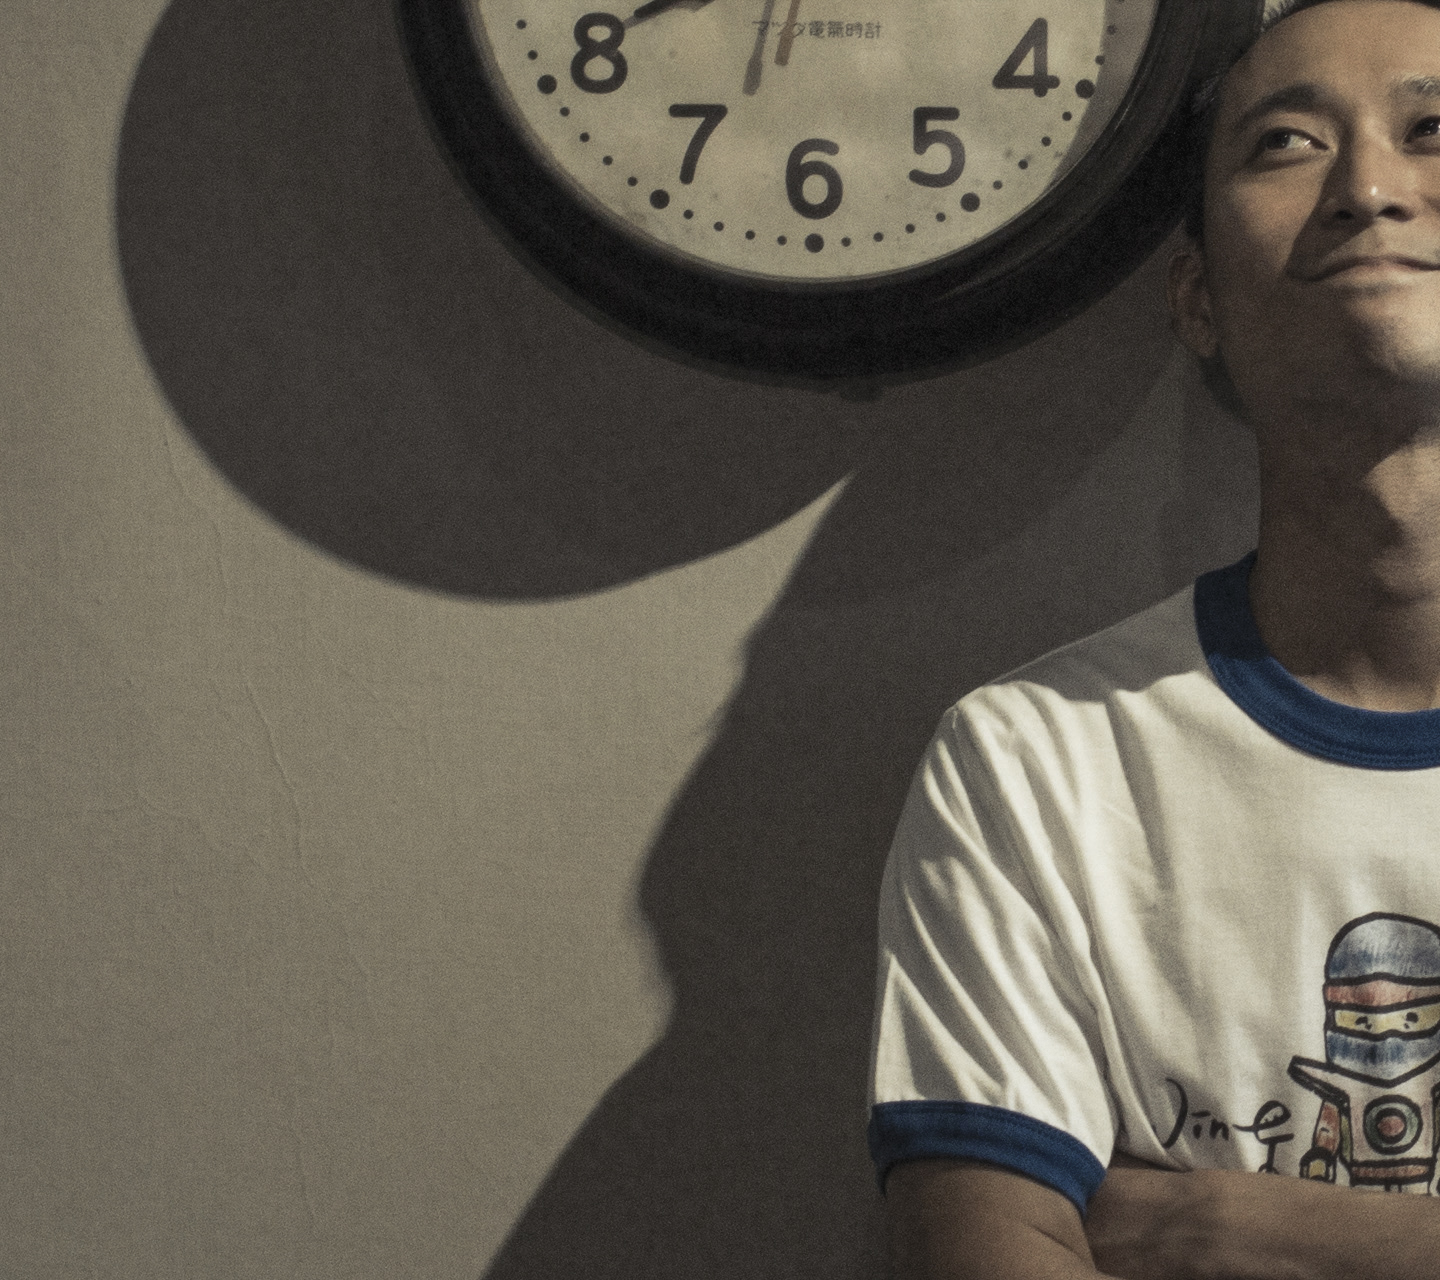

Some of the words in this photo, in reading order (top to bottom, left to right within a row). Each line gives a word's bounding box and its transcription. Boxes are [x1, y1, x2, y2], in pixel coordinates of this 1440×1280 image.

[569, 11, 628, 95] 8
[991, 17, 1060, 98] 4
[667, 103, 729, 185] 7
[785, 138, 844, 220] 6
[908, 106, 967, 188] 5
